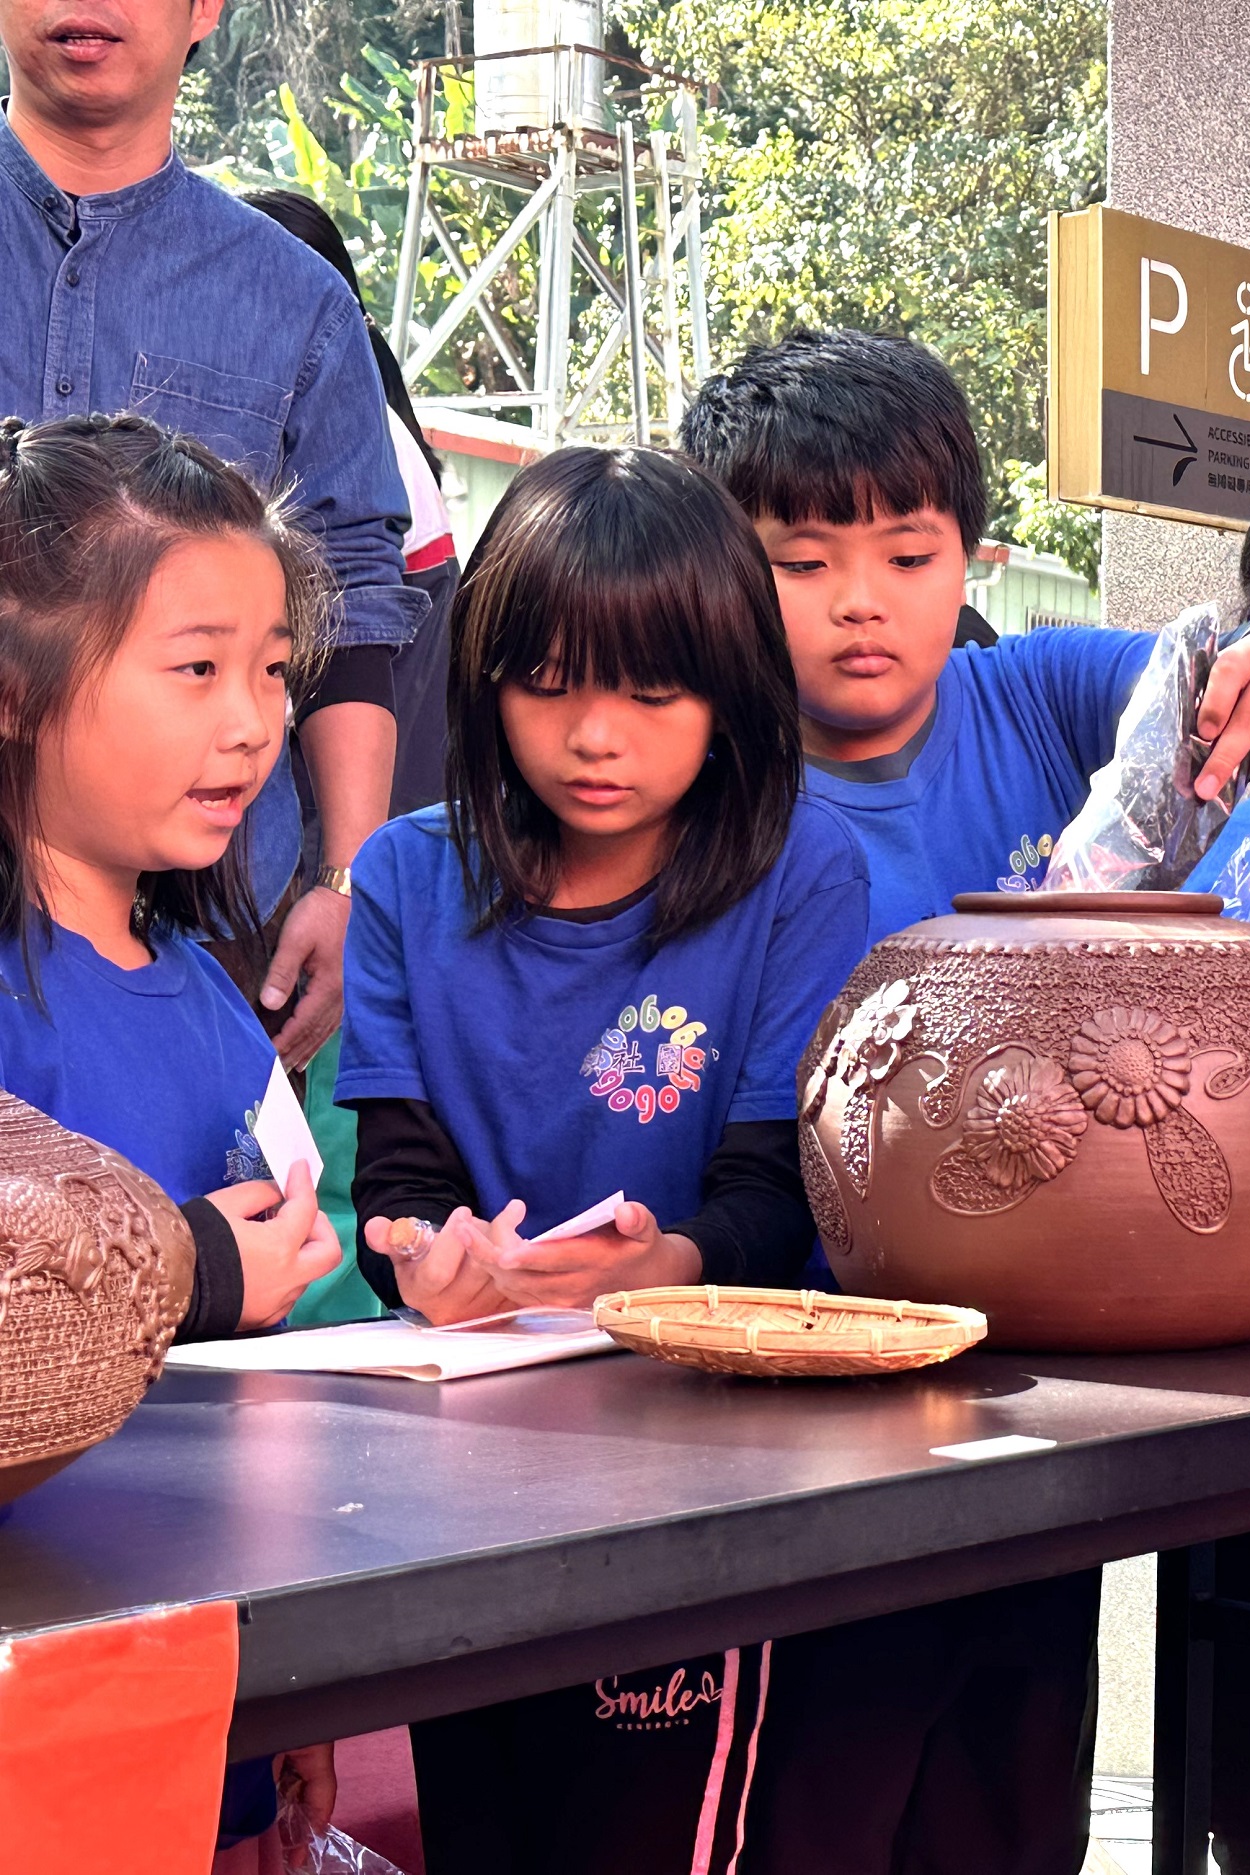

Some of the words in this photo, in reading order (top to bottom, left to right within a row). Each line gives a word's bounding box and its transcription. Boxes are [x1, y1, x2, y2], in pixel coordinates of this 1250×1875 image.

[1140, 257, 1188, 375] P
[1208, 449, 1250, 470] PARKING
[595, 1667, 698, 1719] Smile
